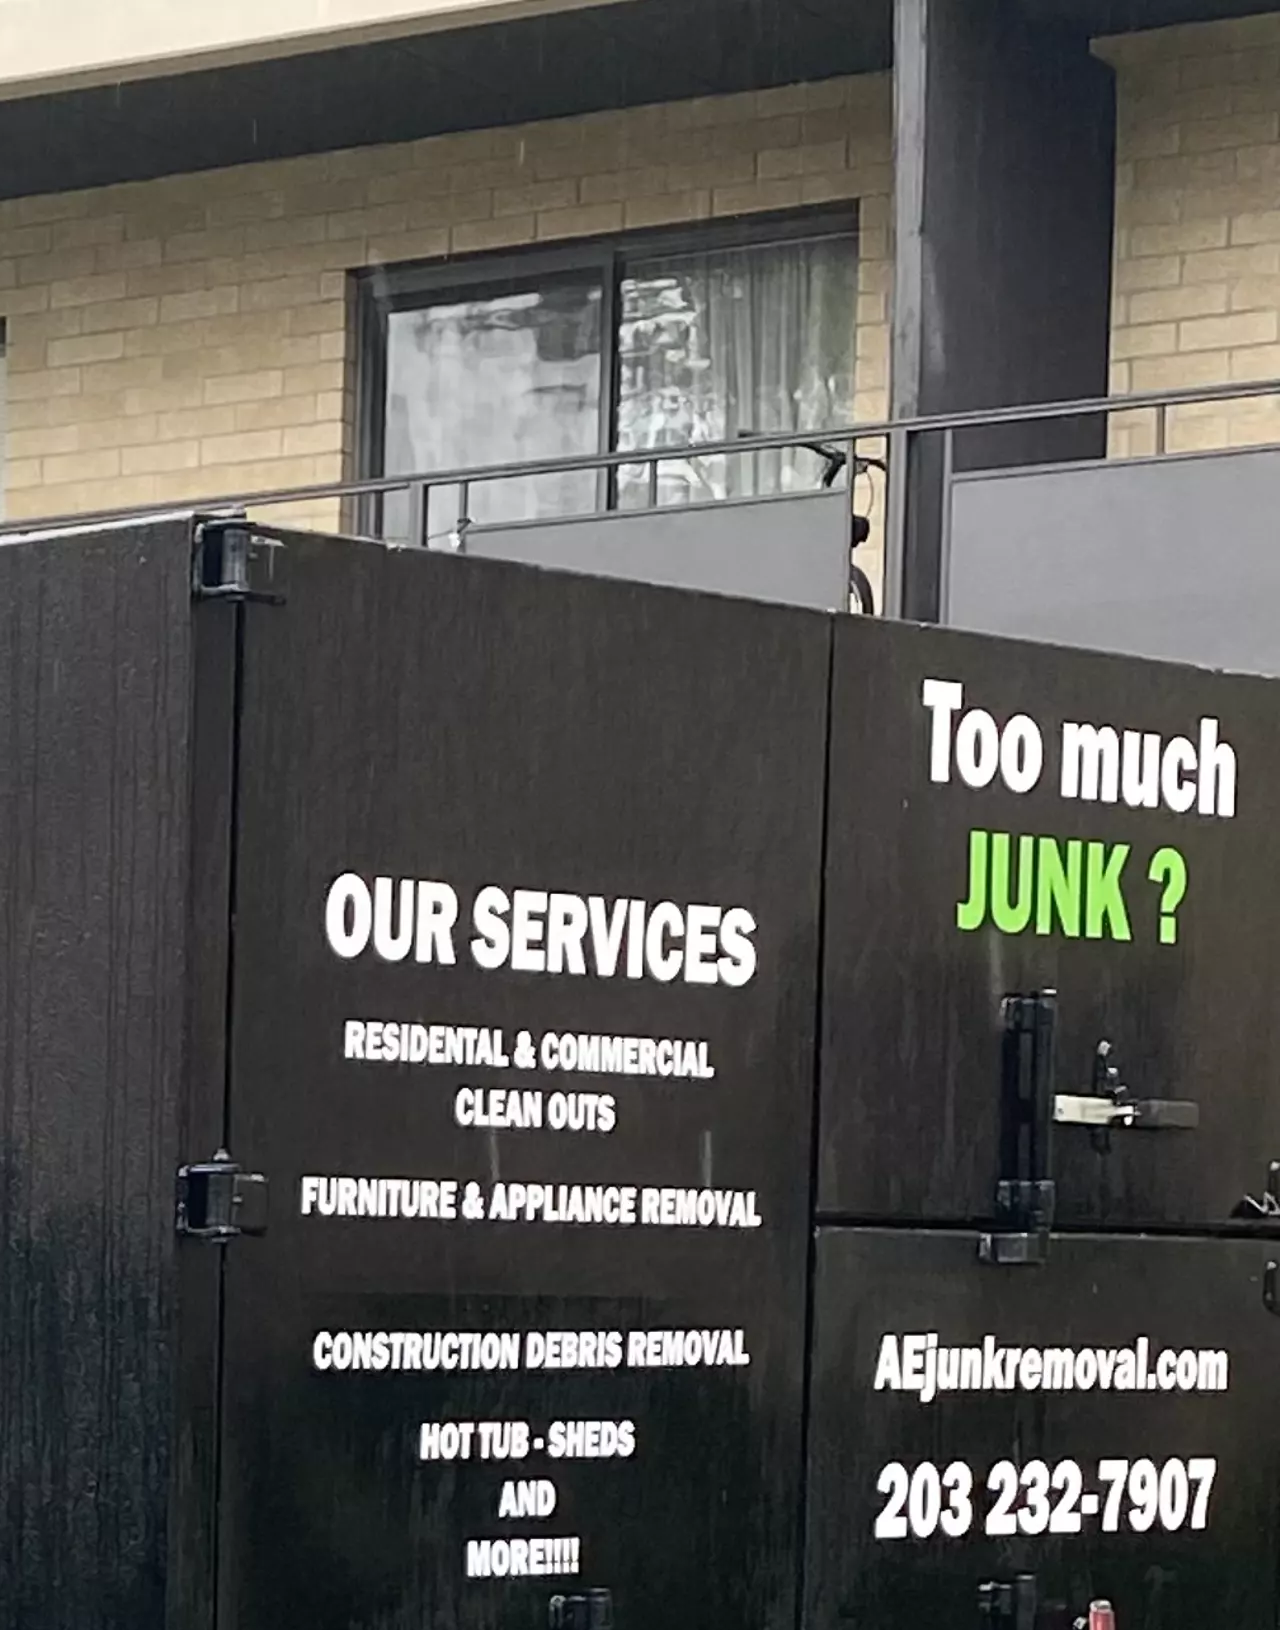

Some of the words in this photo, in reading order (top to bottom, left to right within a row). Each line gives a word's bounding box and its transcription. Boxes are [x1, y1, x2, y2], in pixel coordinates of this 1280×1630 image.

[922, 678, 1043, 793] Too
[1060, 717, 1236, 818] much
[956, 830, 1132, 941] JUNK
[1148, 847, 1187, 945] ?
[325, 873, 458, 965] OUR
[470, 885, 757, 987] SERVICES
[343, 1020, 510, 1068] RESIDENTAL
[513, 1030, 537, 1069] &
[540, 1032, 715, 1079] COMMERCIAL
[454, 1087, 543, 1129] CLEAN
[547, 1091, 616, 1132] OUTS
[300, 1176, 458, 1220] FURNITURE
[461, 1181, 485, 1220] &
[488, 1182, 638, 1224] APPLIANCE
[640, 1187, 762, 1228] REMOVAL
[312, 1331, 521, 1370] CONSTRUCTION
[525, 1331, 623, 1369] DEBRIS
[626, 1329, 750, 1367] REMOVAL
[873, 1332, 1228, 1403] AEjunkremoval.com
[419, 1422, 475, 1460] HOT
[477, 1421, 530, 1460] TUB
[547, 1419, 636, 1458] SHEDS
[498, 1479, 556, 1518] AND
[874, 1461, 973, 1539] 203
[985, 1457, 1217, 1536] 232-7907
[466, 1536, 580, 1578] MORE!!!!
